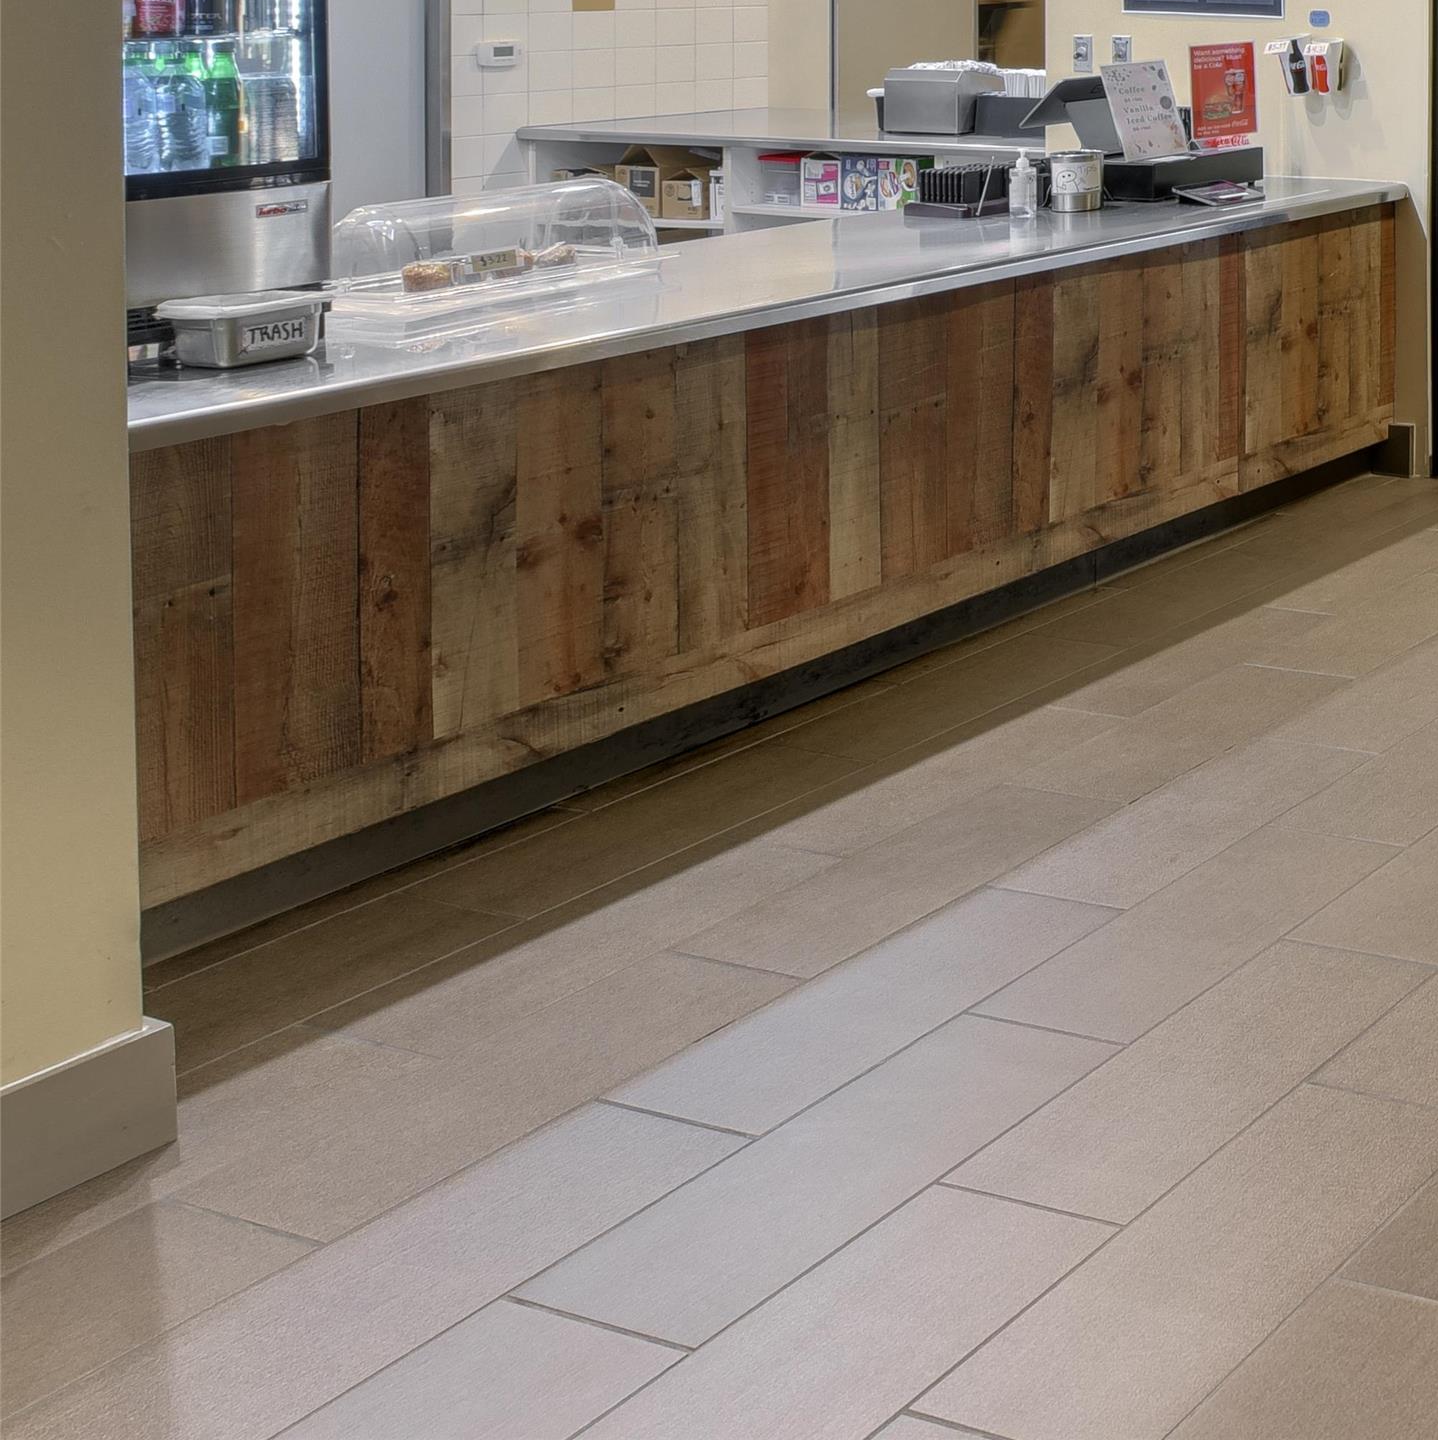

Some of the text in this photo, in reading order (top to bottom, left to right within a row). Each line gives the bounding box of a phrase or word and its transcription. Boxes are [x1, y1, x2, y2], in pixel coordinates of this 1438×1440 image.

[1118, 86, 1145, 96] Coffee
[1123, 104, 1154, 114] Vanilla
[248, 321, 303, 345] TRASH
